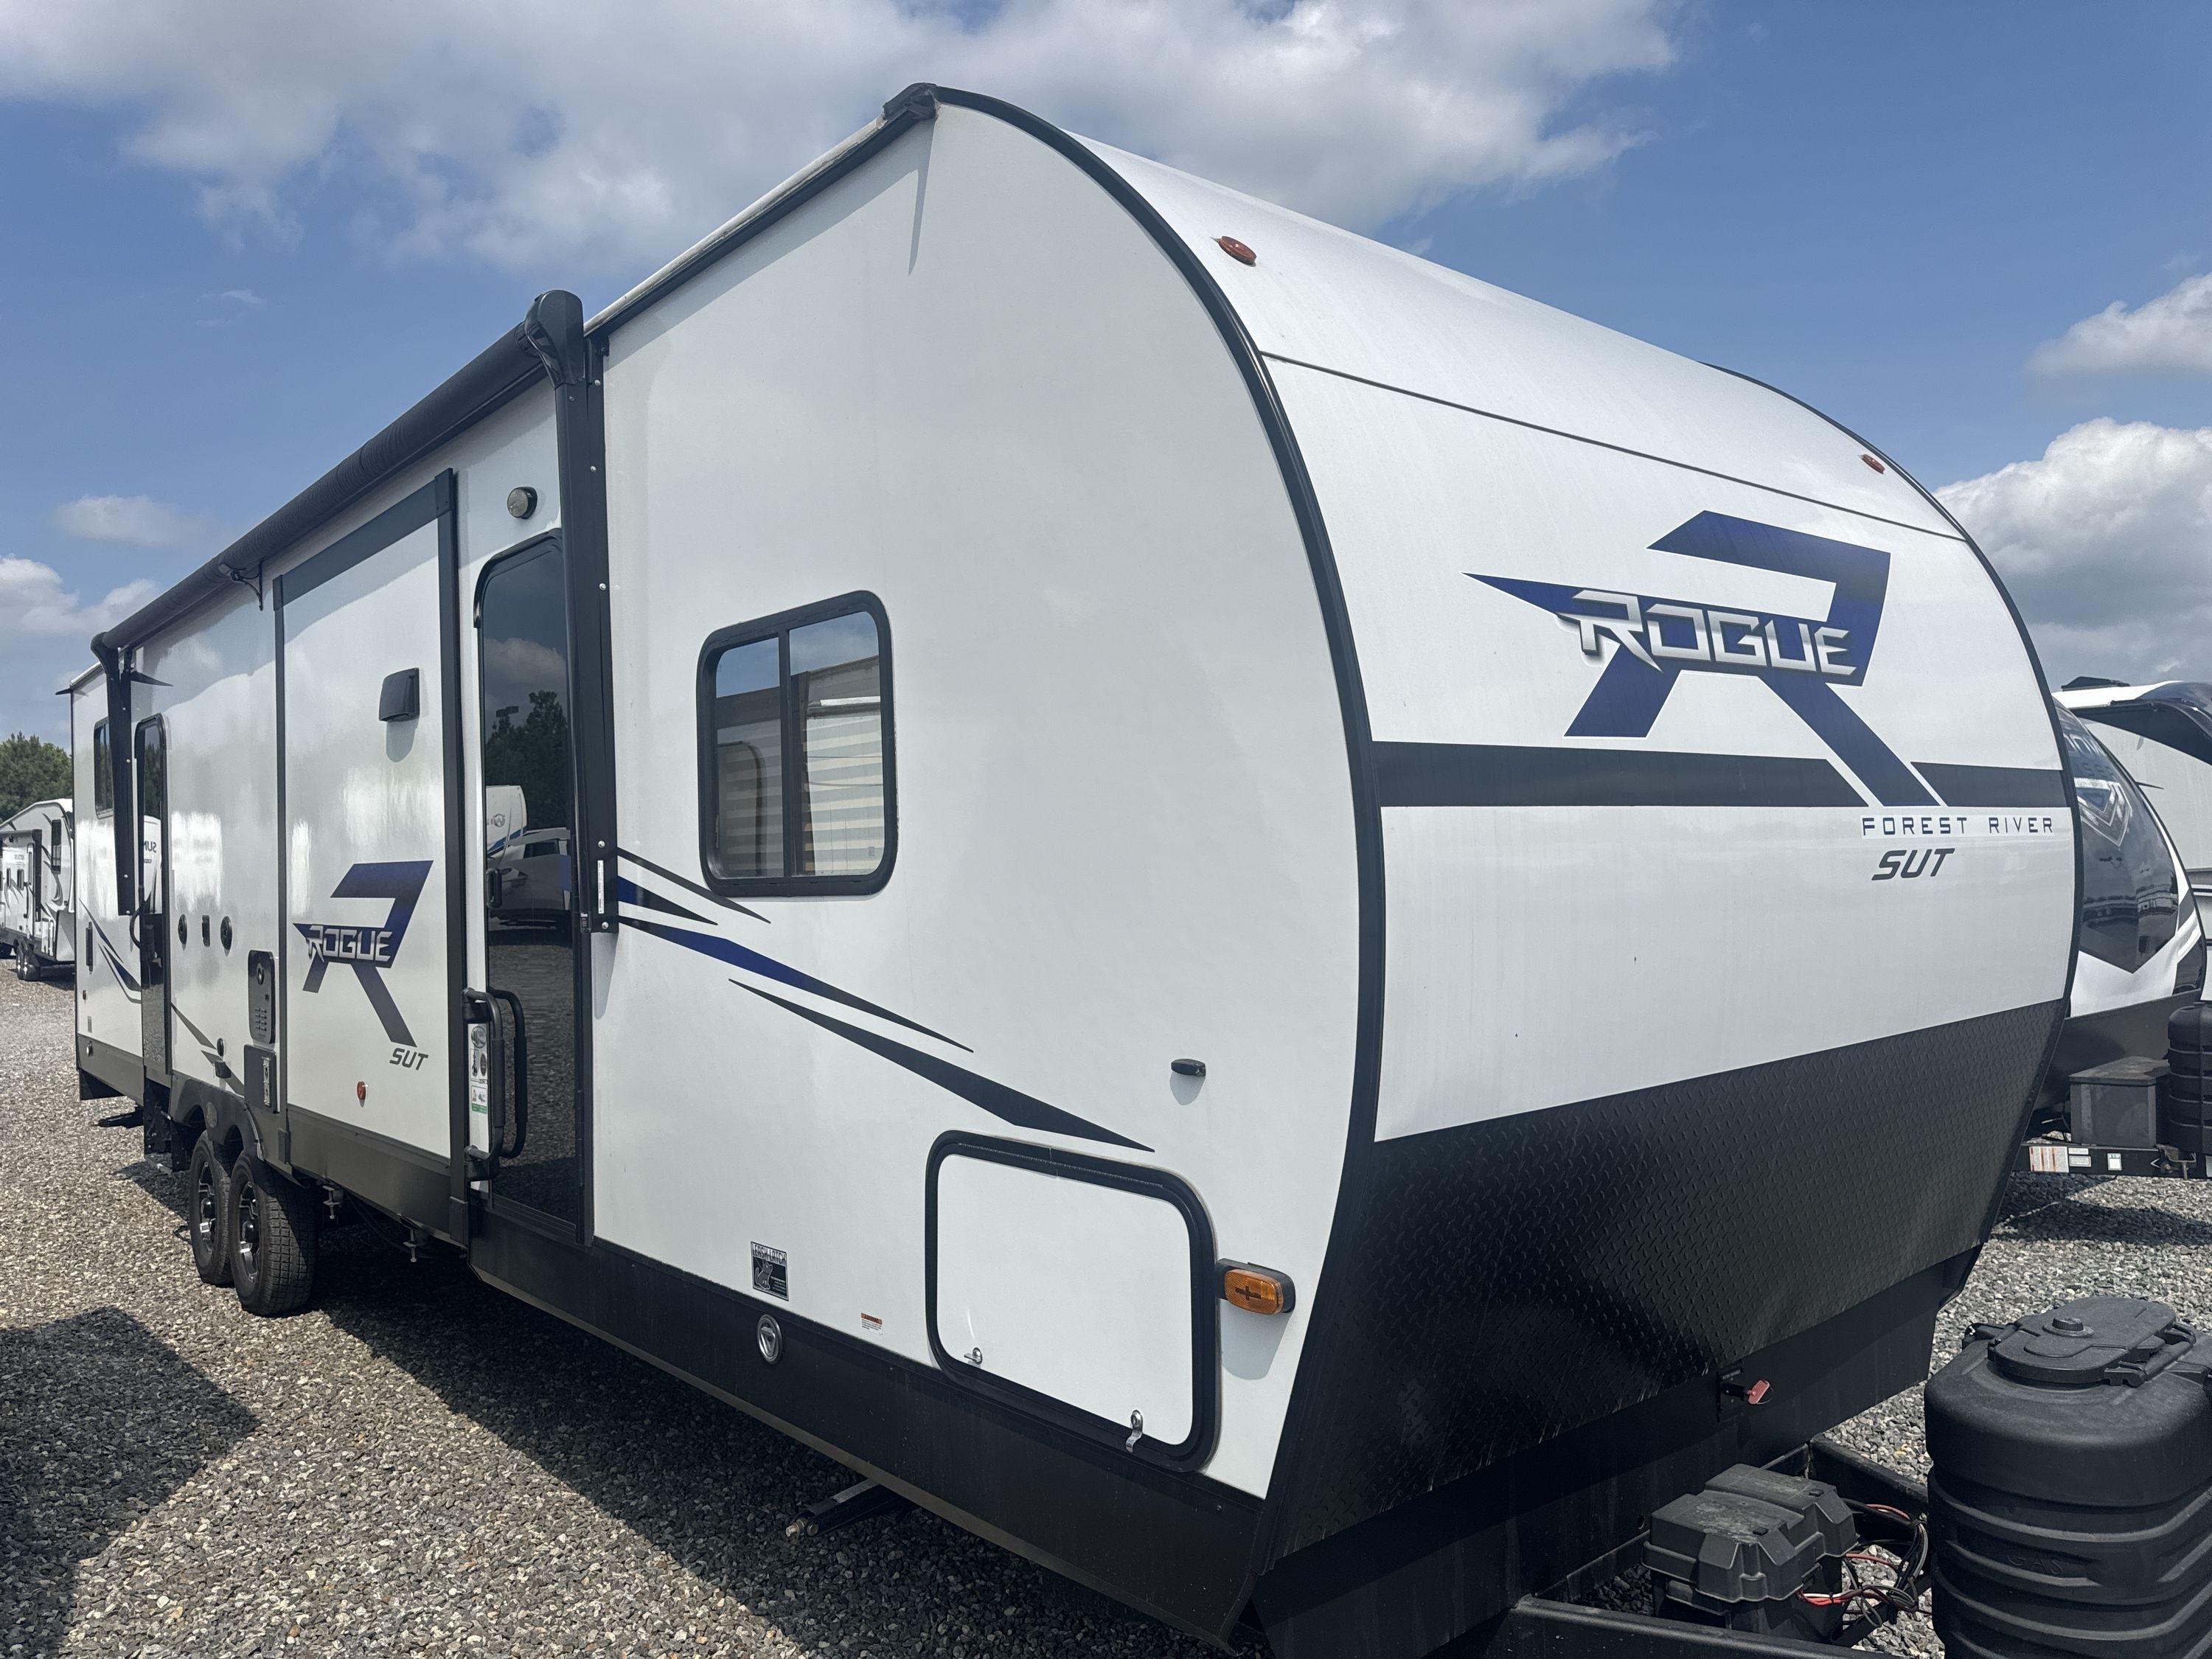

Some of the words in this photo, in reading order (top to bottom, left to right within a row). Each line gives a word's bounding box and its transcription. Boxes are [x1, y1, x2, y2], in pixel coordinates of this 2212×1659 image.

[1557, 589, 1857, 674] ROGUE
[1862, 817, 1967, 836] FOREST
[1988, 816, 2053, 835] RIVER
[1871, 848, 1955, 880] SUT
[305, 925, 392, 963] ROGUE
[389, 1048, 428, 1071] SUT
